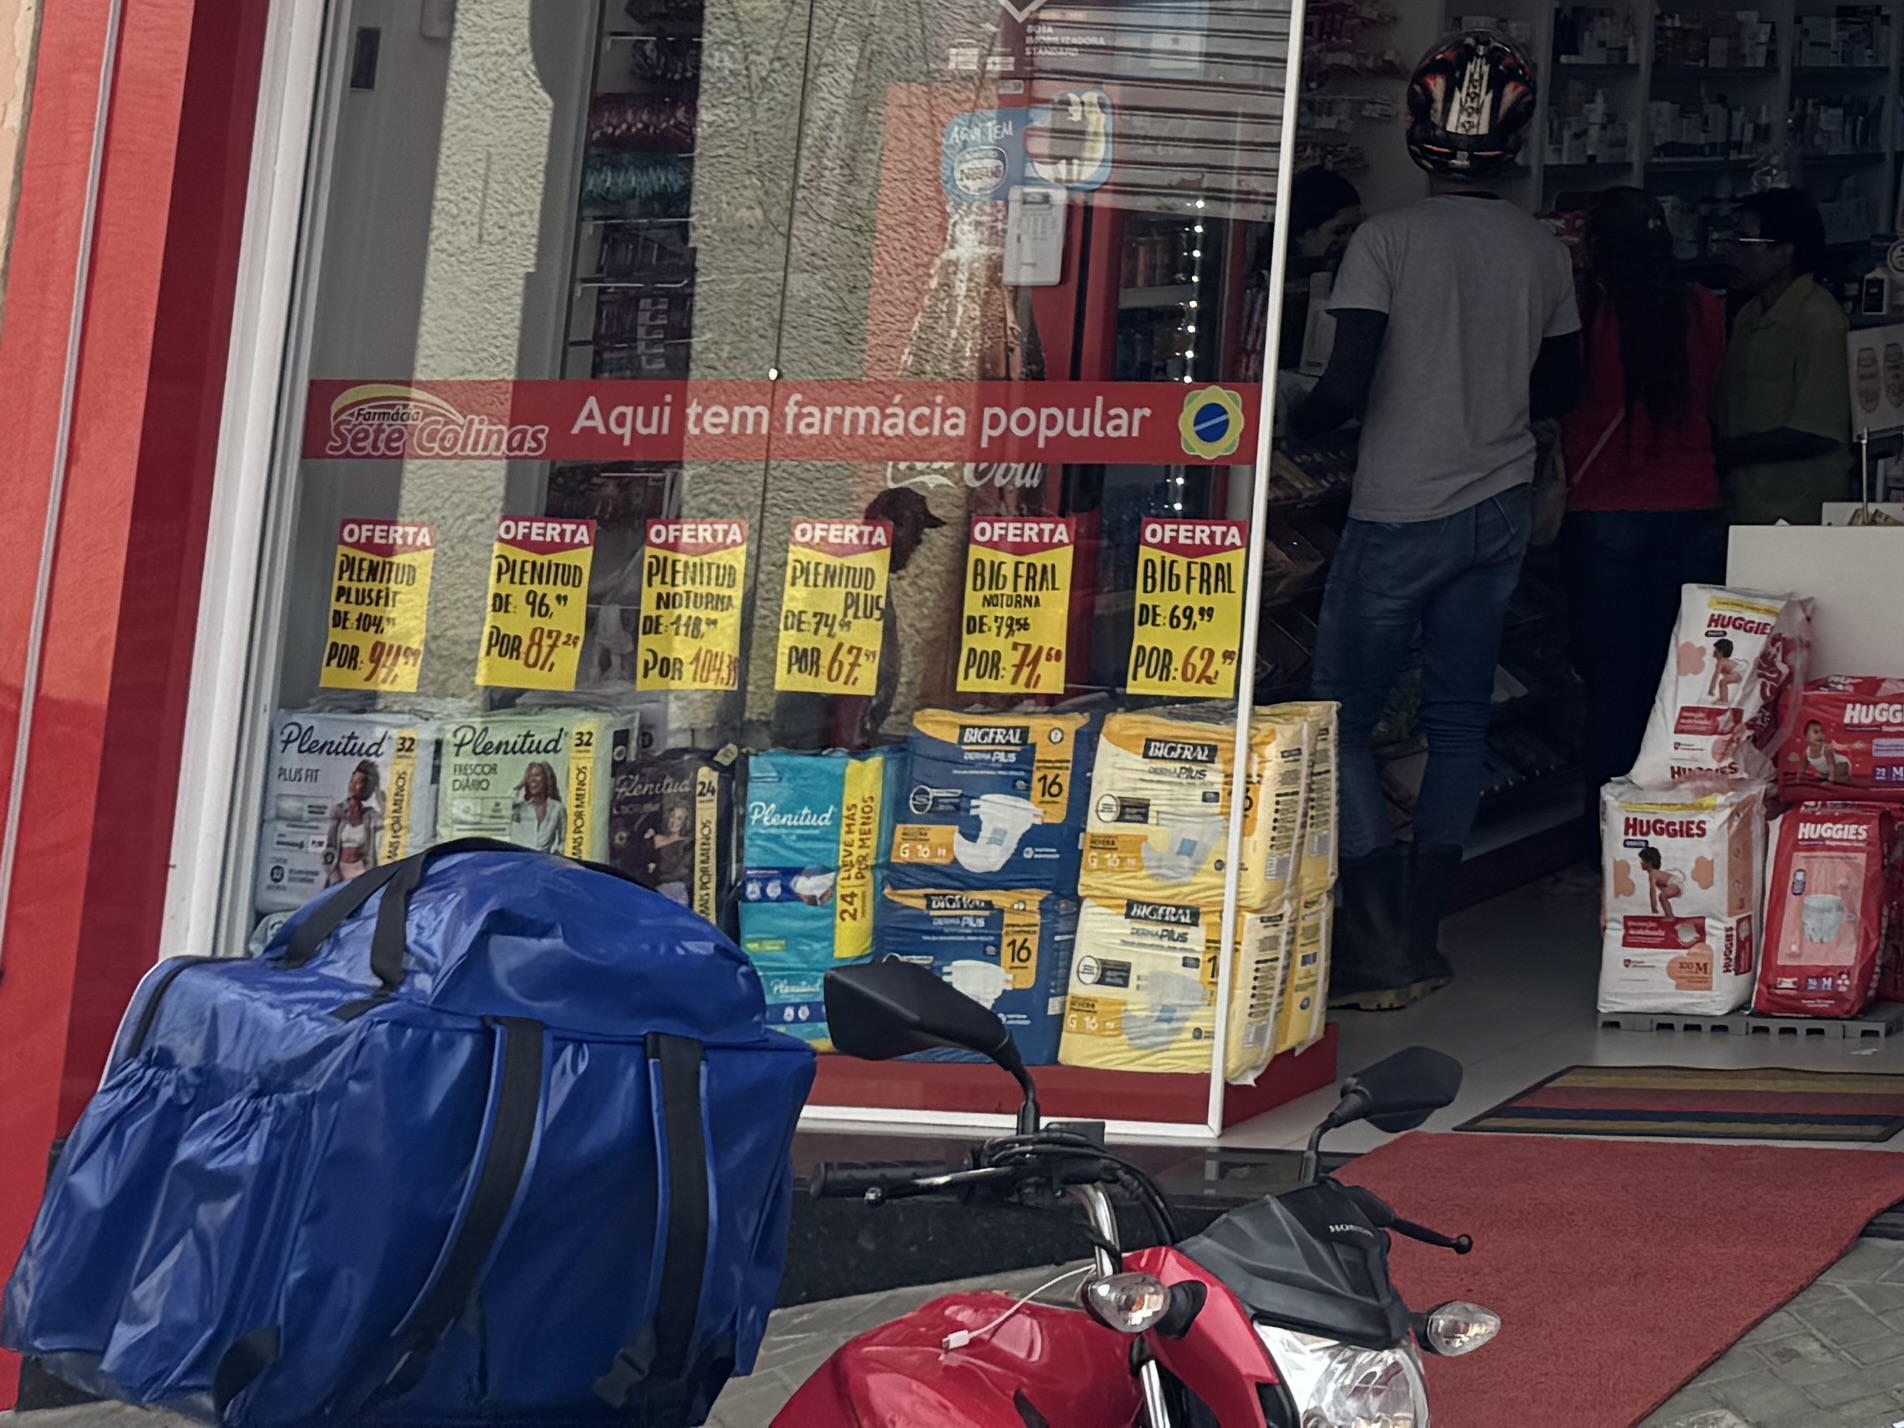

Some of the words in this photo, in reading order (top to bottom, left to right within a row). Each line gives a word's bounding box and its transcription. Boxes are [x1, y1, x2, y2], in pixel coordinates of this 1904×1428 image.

[354, 406, 420, 423] Farmácia
[571, 394, 671, 446] Aqui
[686, 398, 769, 435] tem
[785, 393, 966, 438] farmácia
[981, 396, 1151, 448] popular
[412, 416, 549, 457] Colinas
[342, 524, 431, 545] OFERTA
[499, 520, 590, 543] OFERTA
[650, 523, 743, 543] OFERTA
[795, 523, 887, 545] OFERTA
[974, 522, 1069, 543] OFERTA
[1145, 524, 1242, 545] OFERTA
[338, 554, 417, 586] PLENITUD
[495, 554, 583, 588] PLENITUD
[648, 555, 736, 588] PLENITUD
[791, 560, 875, 590] PLENITUD
[972, 558, 1007, 592] BIG
[1013, 561, 1060, 592] FRAL
[1143, 556, 1180, 593] BIG
[1186, 561, 1236, 595] FRAL
[656, 591, 734, 612] NOTURNA
[843, 592, 883, 621] PLUS
[982, 595, 1041, 609] NOTURNA
[1707, 613, 1774, 636] HUGGIE
[280, 722, 388, 757] Plenitud
[397, 737, 416, 753] 32
[453, 725, 564, 757] Plenitud
[575, 732, 593, 747] 32
[963, 728, 1022, 744] BIGFRAL
[1148, 742, 1210, 761] BIGFRAL
[277, 767, 302, 783] PLUS
[304, 769, 320, 783] FIT
[1037, 774, 1063, 798] 16
[698, 781, 717, 798] 24
[751, 802, 834, 826] Plenitud
[1623, 817, 1707, 838] HUGGIES
[1798, 822, 1868, 839] HUGGIES
[840, 890, 858, 922] 24
[1130, 903, 1193, 923] BIGFRAL
[1007, 938, 1032, 963] 16
